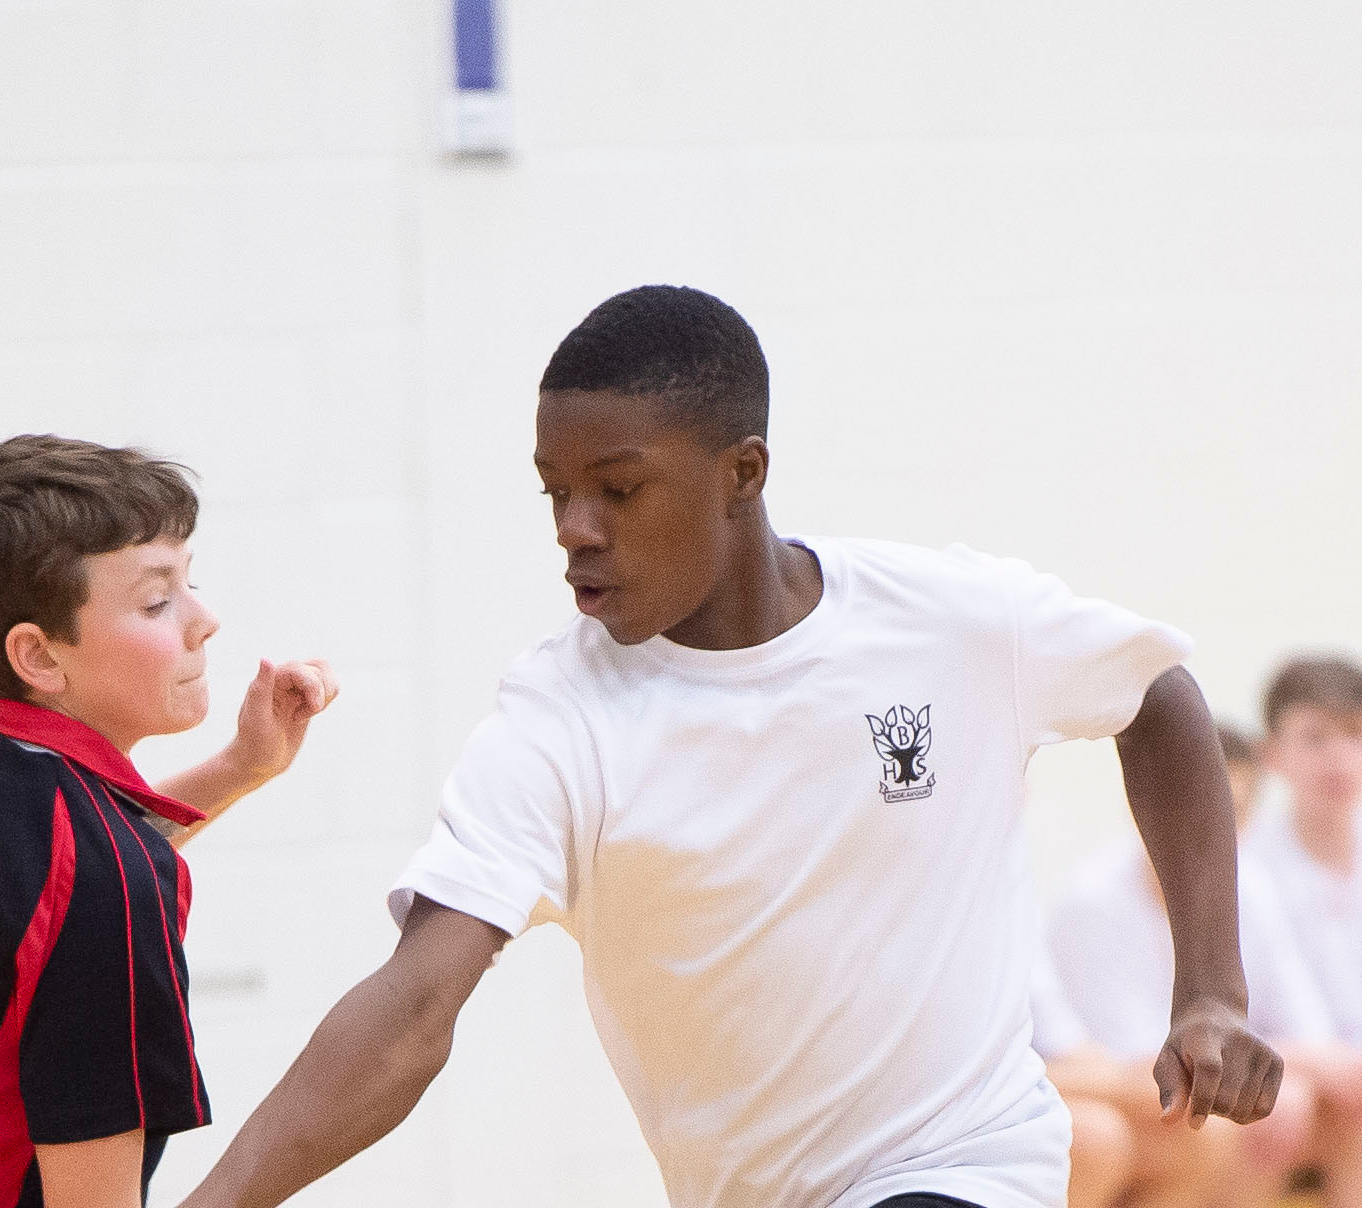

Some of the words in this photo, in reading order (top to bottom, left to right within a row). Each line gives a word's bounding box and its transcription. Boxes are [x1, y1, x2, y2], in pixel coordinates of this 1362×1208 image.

[897, 726, 910, 746] B
[883, 762, 897, 781] H
[915, 757, 927, 775] S
